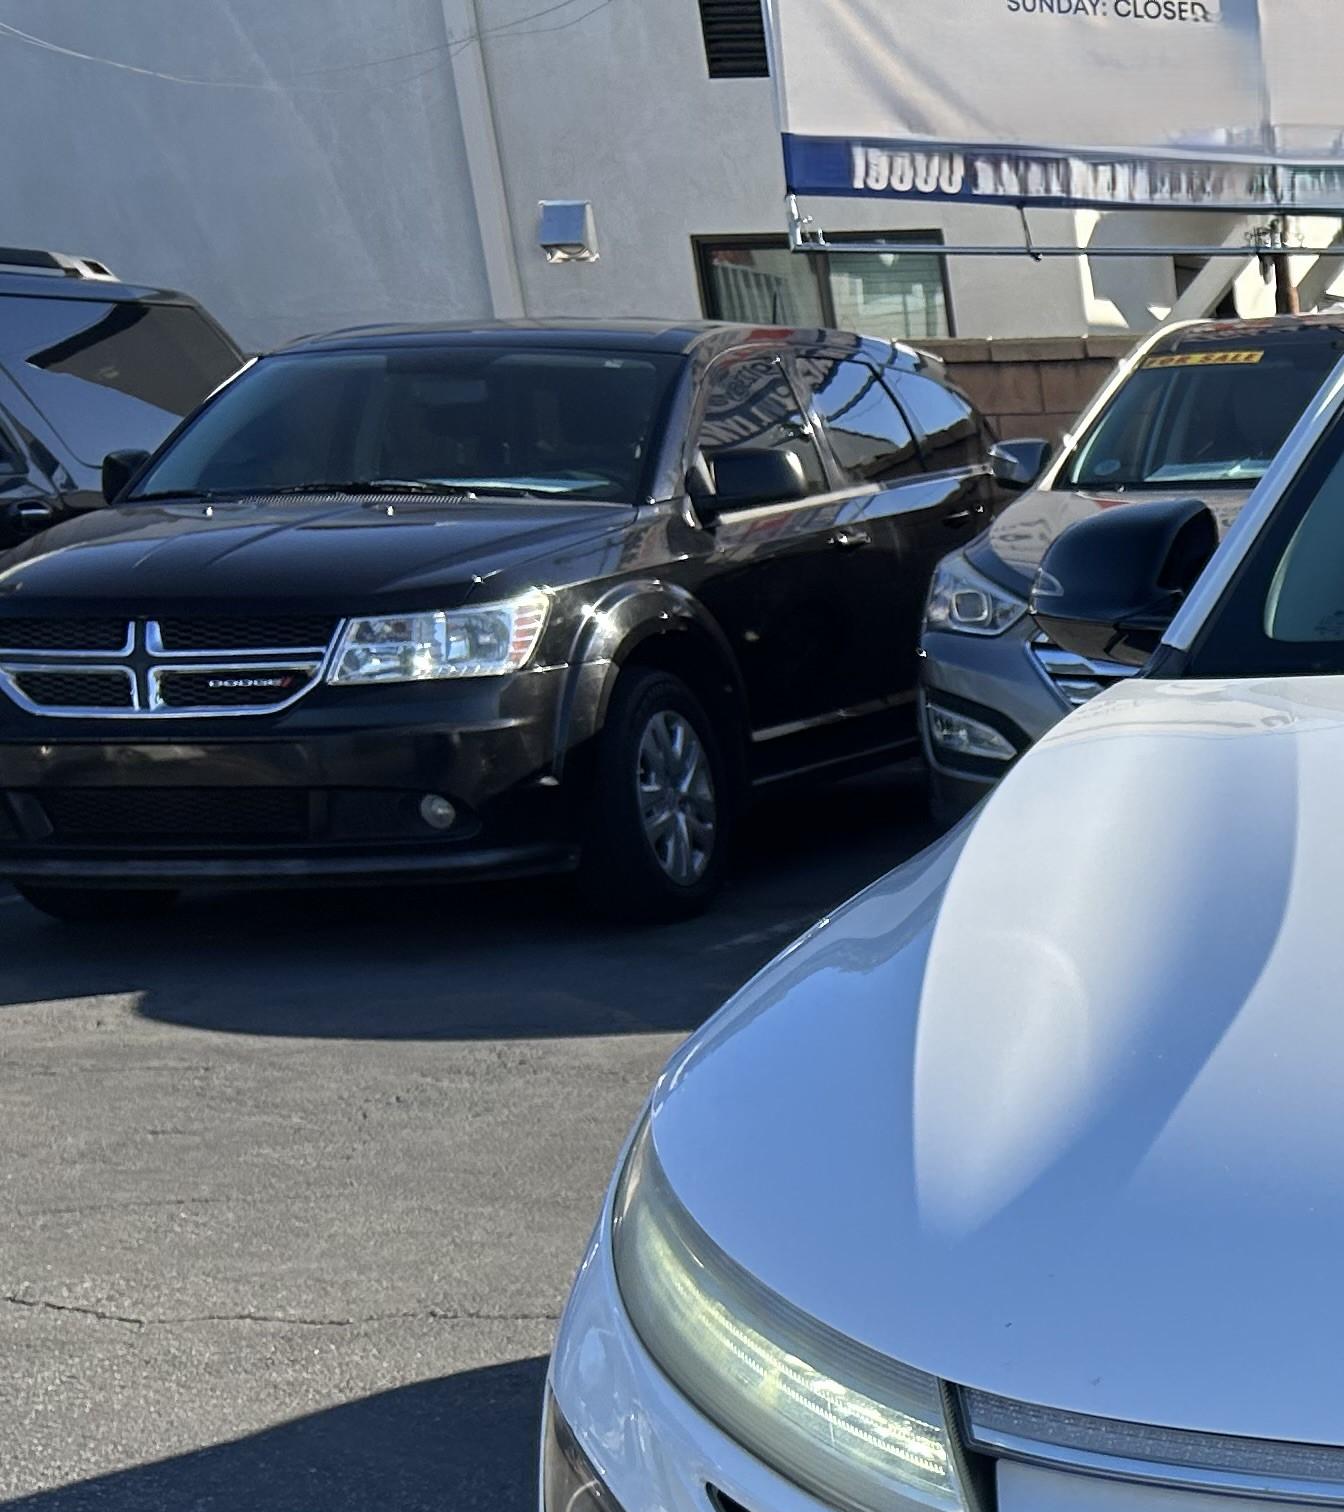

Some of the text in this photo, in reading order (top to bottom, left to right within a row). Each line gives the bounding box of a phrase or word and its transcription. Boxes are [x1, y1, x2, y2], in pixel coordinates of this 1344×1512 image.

[1007, 0, 1107, 17] SUNDAY:
[1145, 351, 1260, 366] FOR SALE
